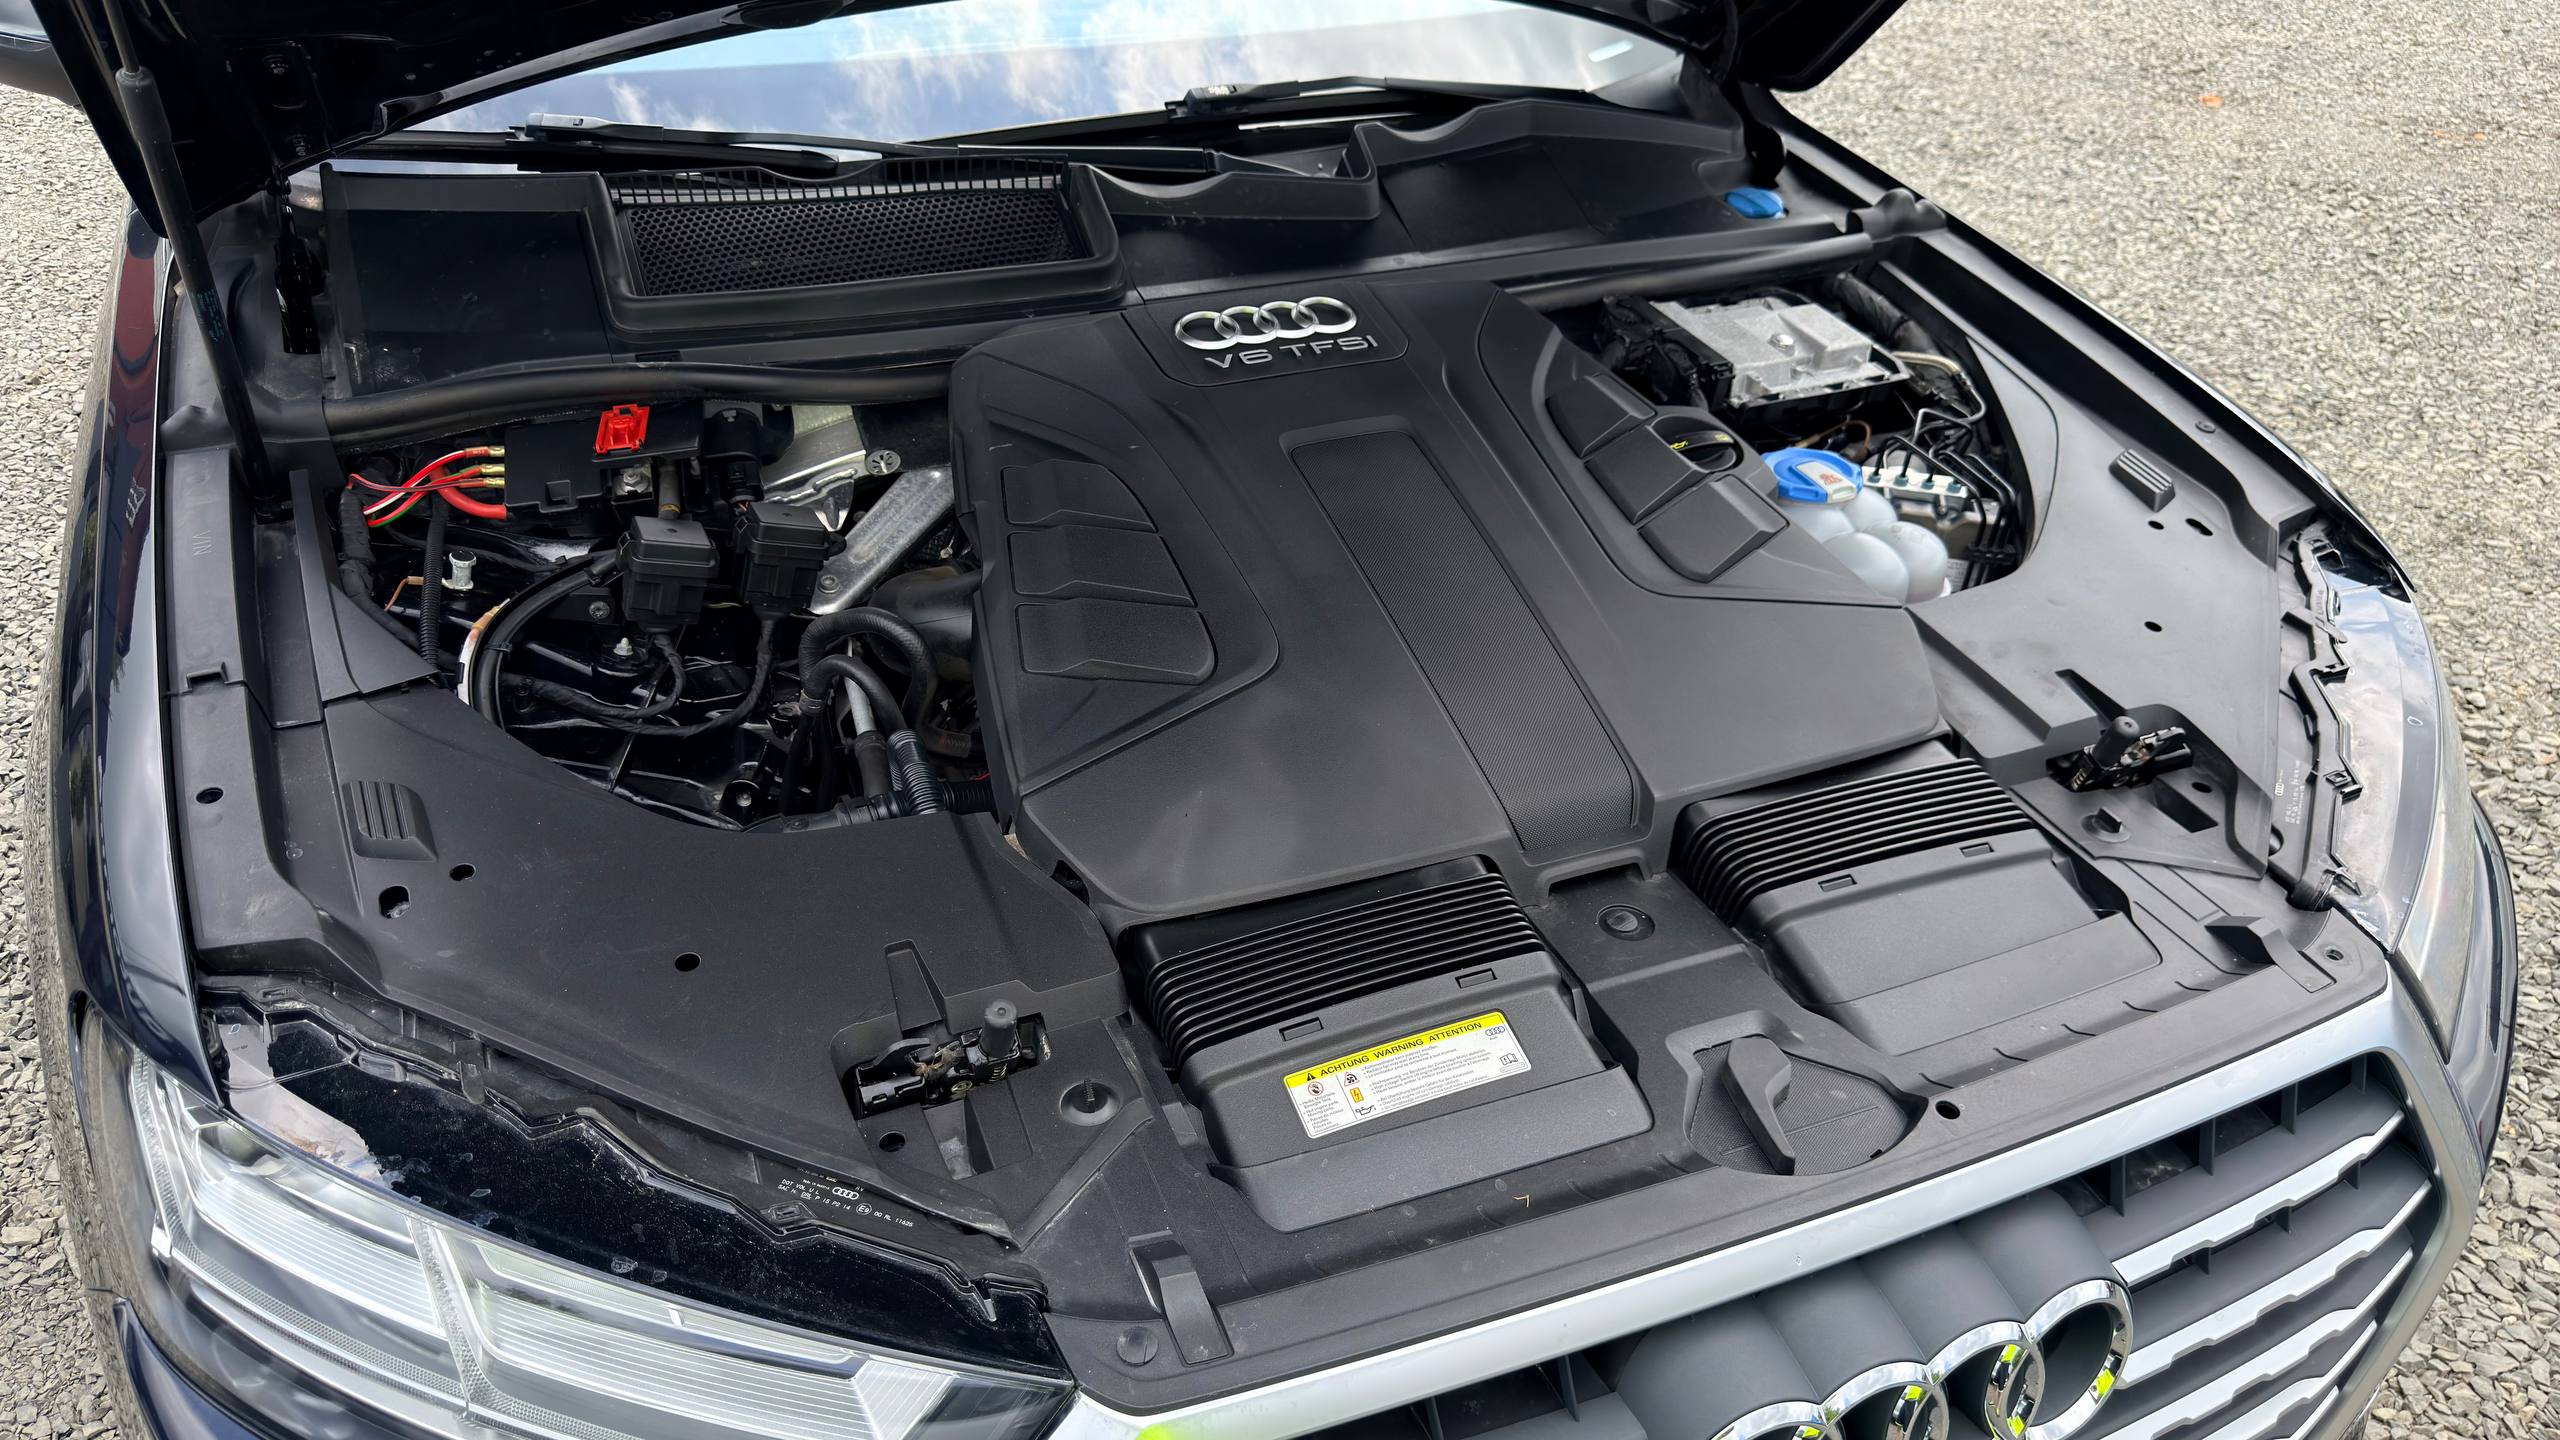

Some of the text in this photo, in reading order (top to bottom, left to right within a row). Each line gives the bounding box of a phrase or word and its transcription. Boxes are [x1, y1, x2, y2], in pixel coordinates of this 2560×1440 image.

[1204, 335, 1379, 369] V6 TFSI
[1320, 1054, 1370, 1077] ACHTUNG
[1373, 1038, 1424, 1059] WARNING
[1429, 1021, 1482, 1043] ATTENTION
